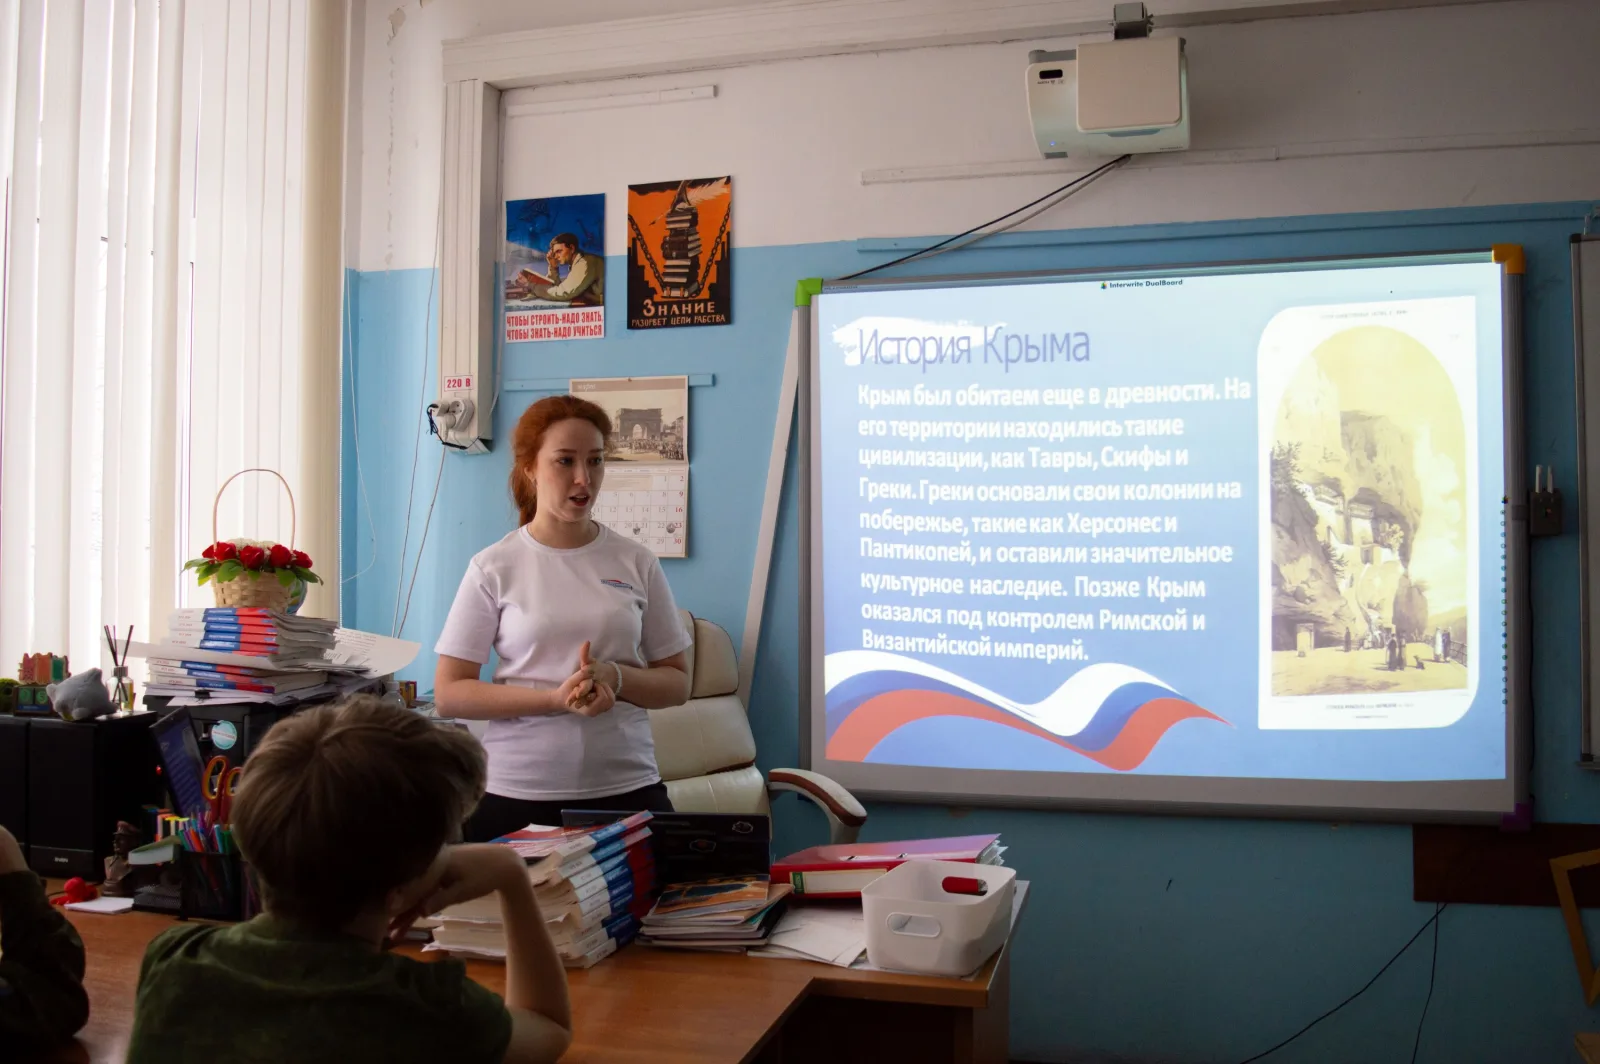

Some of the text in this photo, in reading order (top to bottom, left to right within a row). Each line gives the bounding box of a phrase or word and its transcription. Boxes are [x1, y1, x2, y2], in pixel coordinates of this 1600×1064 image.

[1145, 279, 1183, 287] DualBoard
[506, 315, 529, 327] ЧТОБЫ
[506, 329, 529, 341] ЧТОБЫ
[573, 324, 603, 337] УЧИТЬСЯ
[631, 314, 726, 327] РАЗОРВЕТ ЦЕПИ РАБСТВА
[858, 325, 1091, 373] История Крыма
[447, 378, 462, 388] 220
[859, 377, 1251, 409] Крым был обитаем еще в древности. На
[859, 418, 1184, 442] его территории находились такие
[859, 445, 1188, 472] цивилизации, как Тавры, Скифы и
[860, 477, 1242, 504] Греки. Греки основали свои колонии на
[860, 508, 1177, 538] побережье, такие как Херсонес и
[980, 547, 991, 562] и
[997, 547, 1087, 563] оставили
[1091, 546, 1232, 563] значительное
[861, 573, 1206, 602] культурное наследие. Позже Крым
[862, 604, 1205, 632] оказался под контролем Римской и
[861, 628, 1088, 664] Византийской империй.
